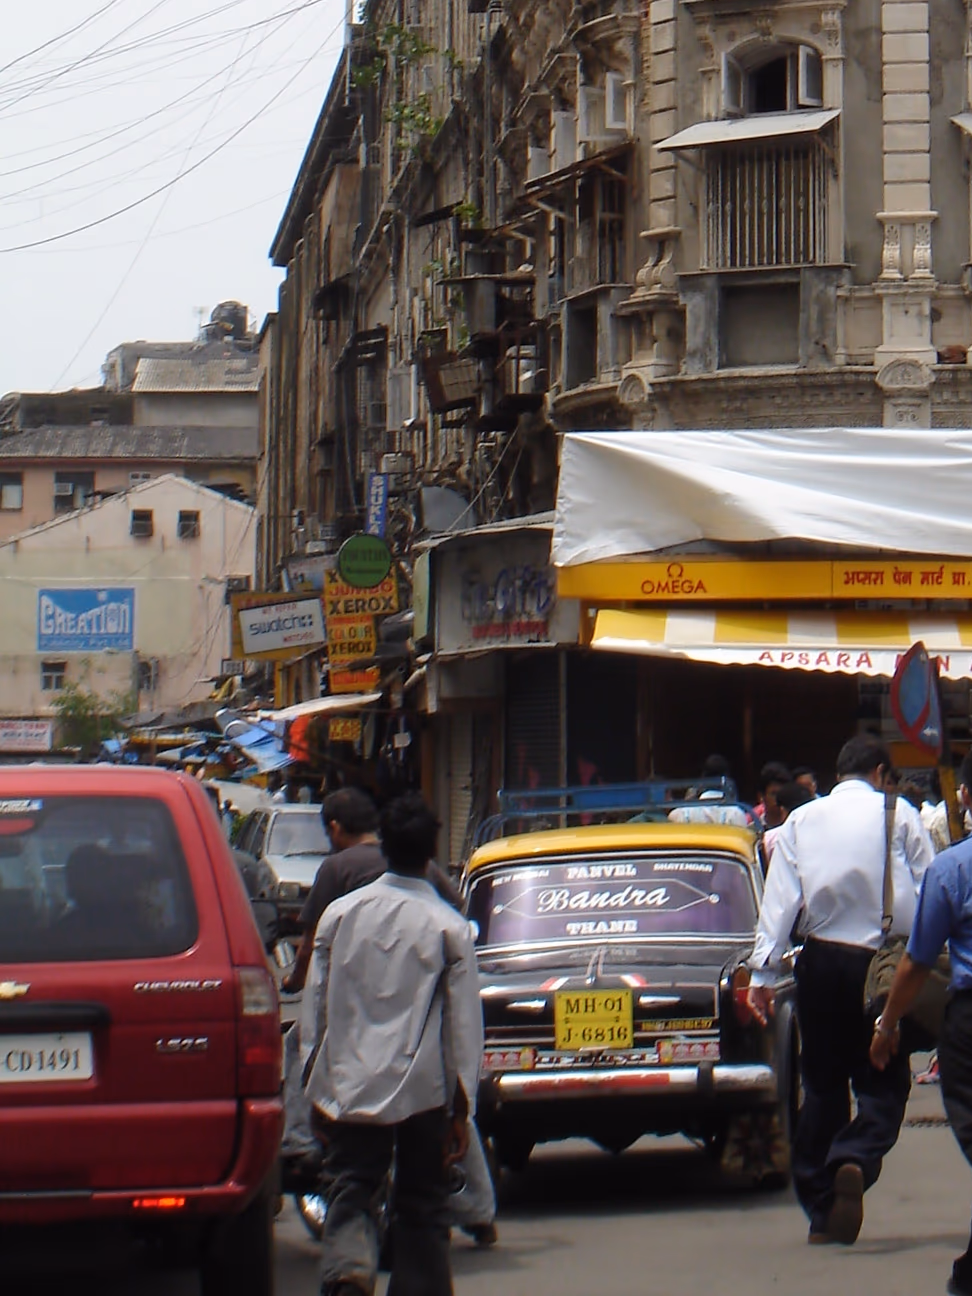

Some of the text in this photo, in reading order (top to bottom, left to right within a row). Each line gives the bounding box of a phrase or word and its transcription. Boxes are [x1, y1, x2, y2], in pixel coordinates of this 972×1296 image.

[368, 476, 384, 534] SHUKLA
[843, 570, 885, 586] अप्सरा
[920, 565, 945, 585] मार्ट
[641, 579, 707, 595] OMEGA
[41, 594, 130, 634] CREATION
[328, 595, 395, 615] XEROX
[249, 614, 301, 635] swatch
[330, 641, 373, 655] XEROX
[758, 651, 873, 669] APSARA
[567, 864, 637, 879] PANVEL
[537, 885, 670, 913] Bandra
[566, 920, 638, 935] THANE
[133, 980, 222, 993] CHEVROLET
